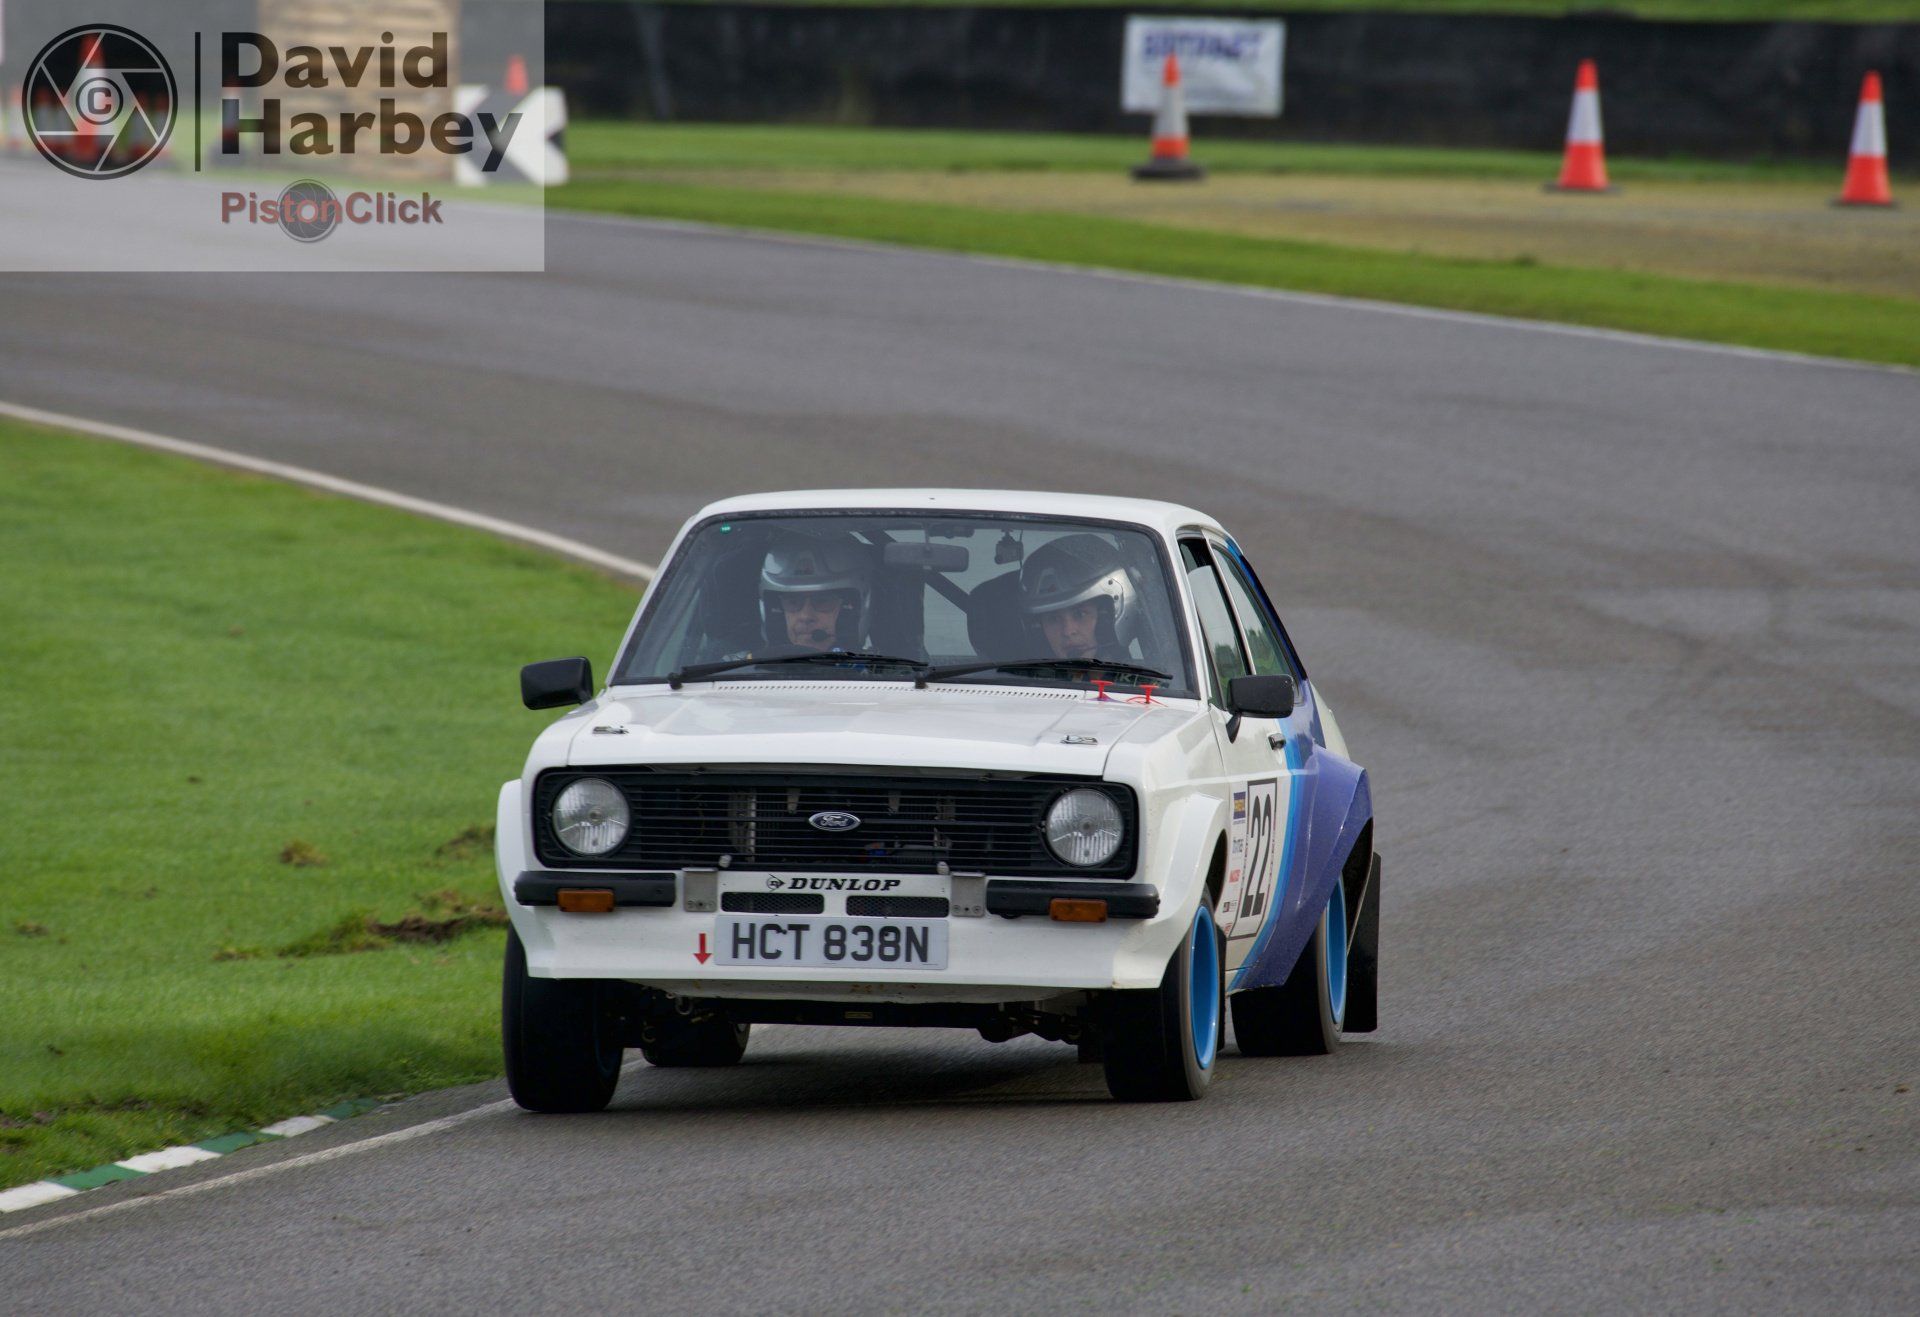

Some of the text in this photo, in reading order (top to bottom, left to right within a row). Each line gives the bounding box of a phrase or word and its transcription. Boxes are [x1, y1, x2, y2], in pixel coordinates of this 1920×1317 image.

[1240, 793, 1272, 918] 22
[788, 877, 901, 891] DUNLOP
[731, 922, 929, 963] HCT 838N
